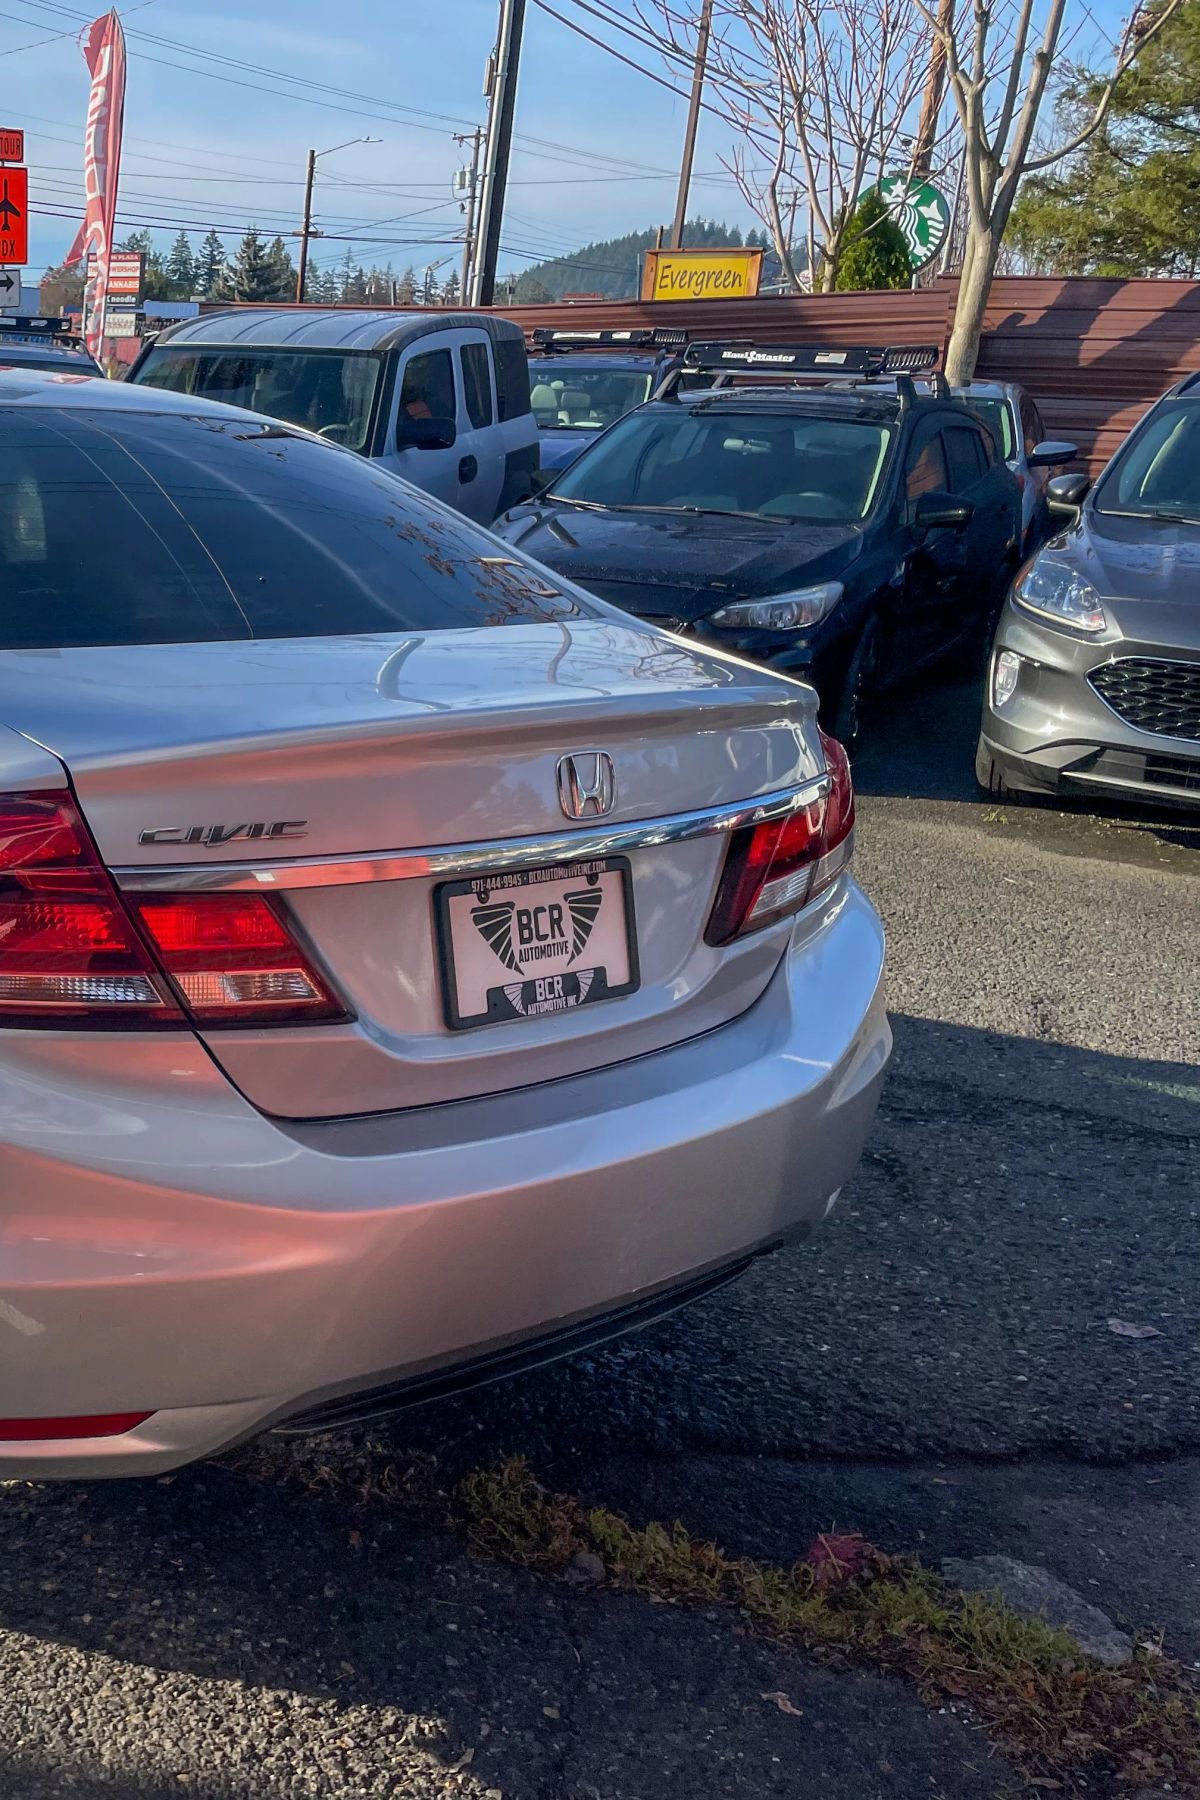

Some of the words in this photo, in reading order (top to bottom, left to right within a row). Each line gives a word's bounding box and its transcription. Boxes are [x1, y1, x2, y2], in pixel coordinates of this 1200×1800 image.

[108, 281, 139, 289] ANNABIS
[658, 264, 742, 297] Evergreen
[138, 820, 308, 847] CIVIC
[471, 873, 522, 893] 971-444-9945
[516, 903, 566, 946] BCR
[518, 940, 570, 964] AUTOMOTIVE
[535, 975, 564, 1002] BCR
[527, 997, 567, 1017] AUTOMOTIVE
